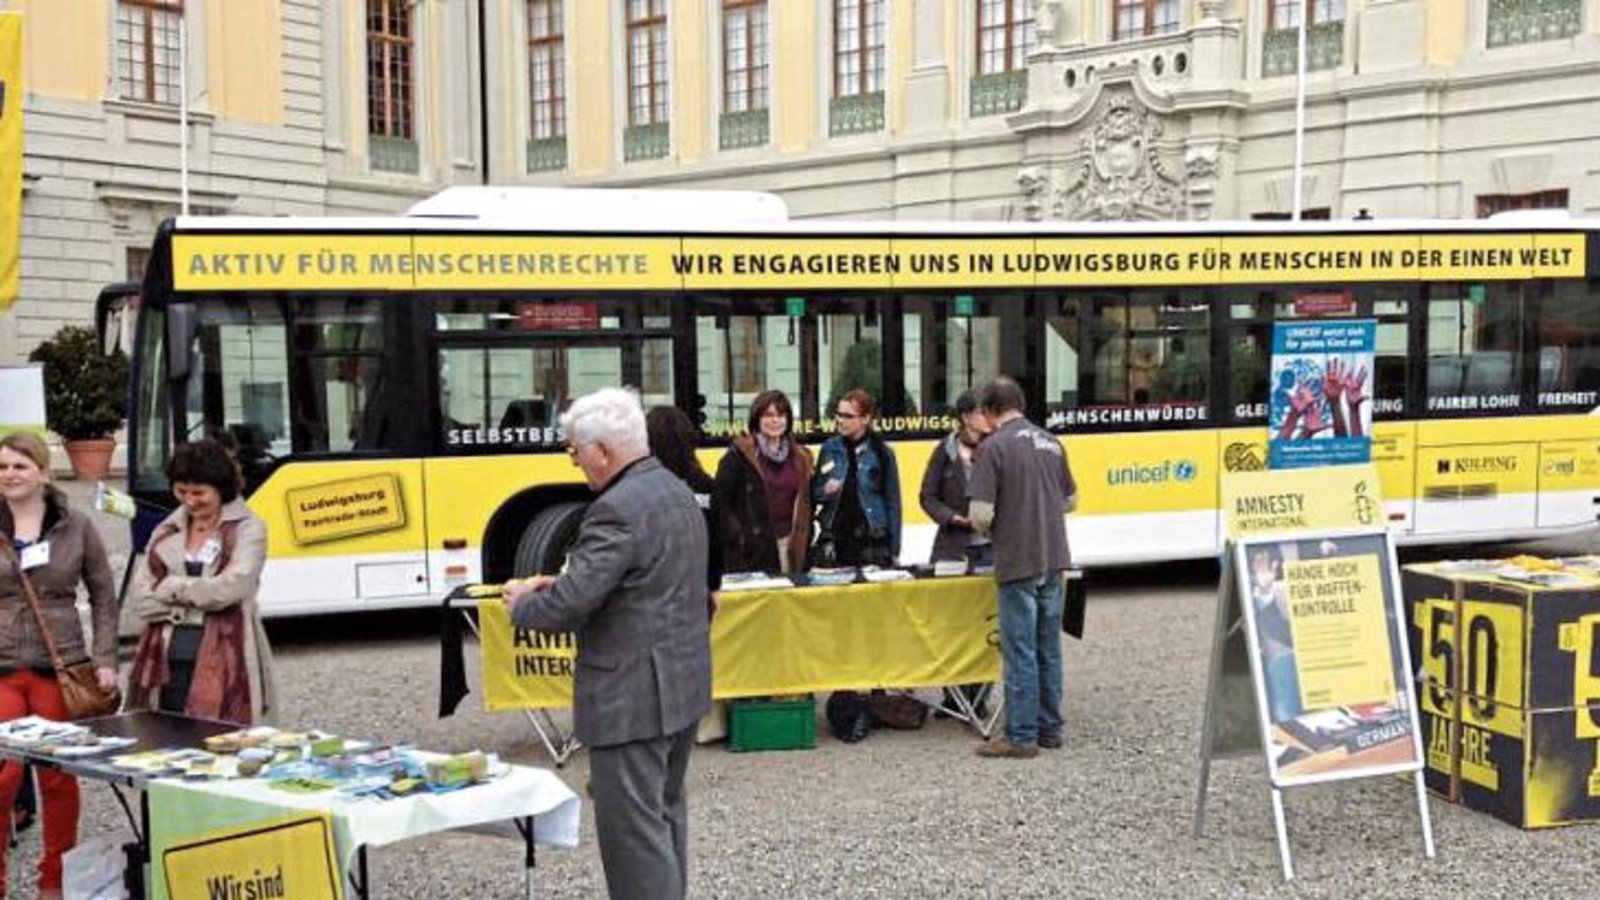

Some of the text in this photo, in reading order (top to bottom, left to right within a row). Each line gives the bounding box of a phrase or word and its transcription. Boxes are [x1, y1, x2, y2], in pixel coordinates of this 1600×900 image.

[188, 248, 650, 275] AKTIV FÜR MENSCHENRECHTE
[671, 247, 1572, 274] WIR ENGAGIEREN UNS IN LUDWIGSBURG FÜR MENSCHEN IN DER EINEN WELT
[1428, 394, 1520, 410] FAIRER LOHN
[1538, 392, 1596, 405] FREIHEIT
[1051, 404, 1206, 425] MENSCHENWÜRDE
[1107, 460, 1172, 485] unicef
[1455, 456, 1517, 473] KOLPING
[300, 489, 386, 512] Ludwigsburg
[1235, 492, 1305, 515] AMNESTY
[1328, 561, 1359, 578] HOCH
[1289, 580, 1313, 600] FÜR
[1292, 598, 1357, 617] KONTROLLE
[1429, 606, 1499, 724] 50
[207, 864, 284, 900] Wir sind
